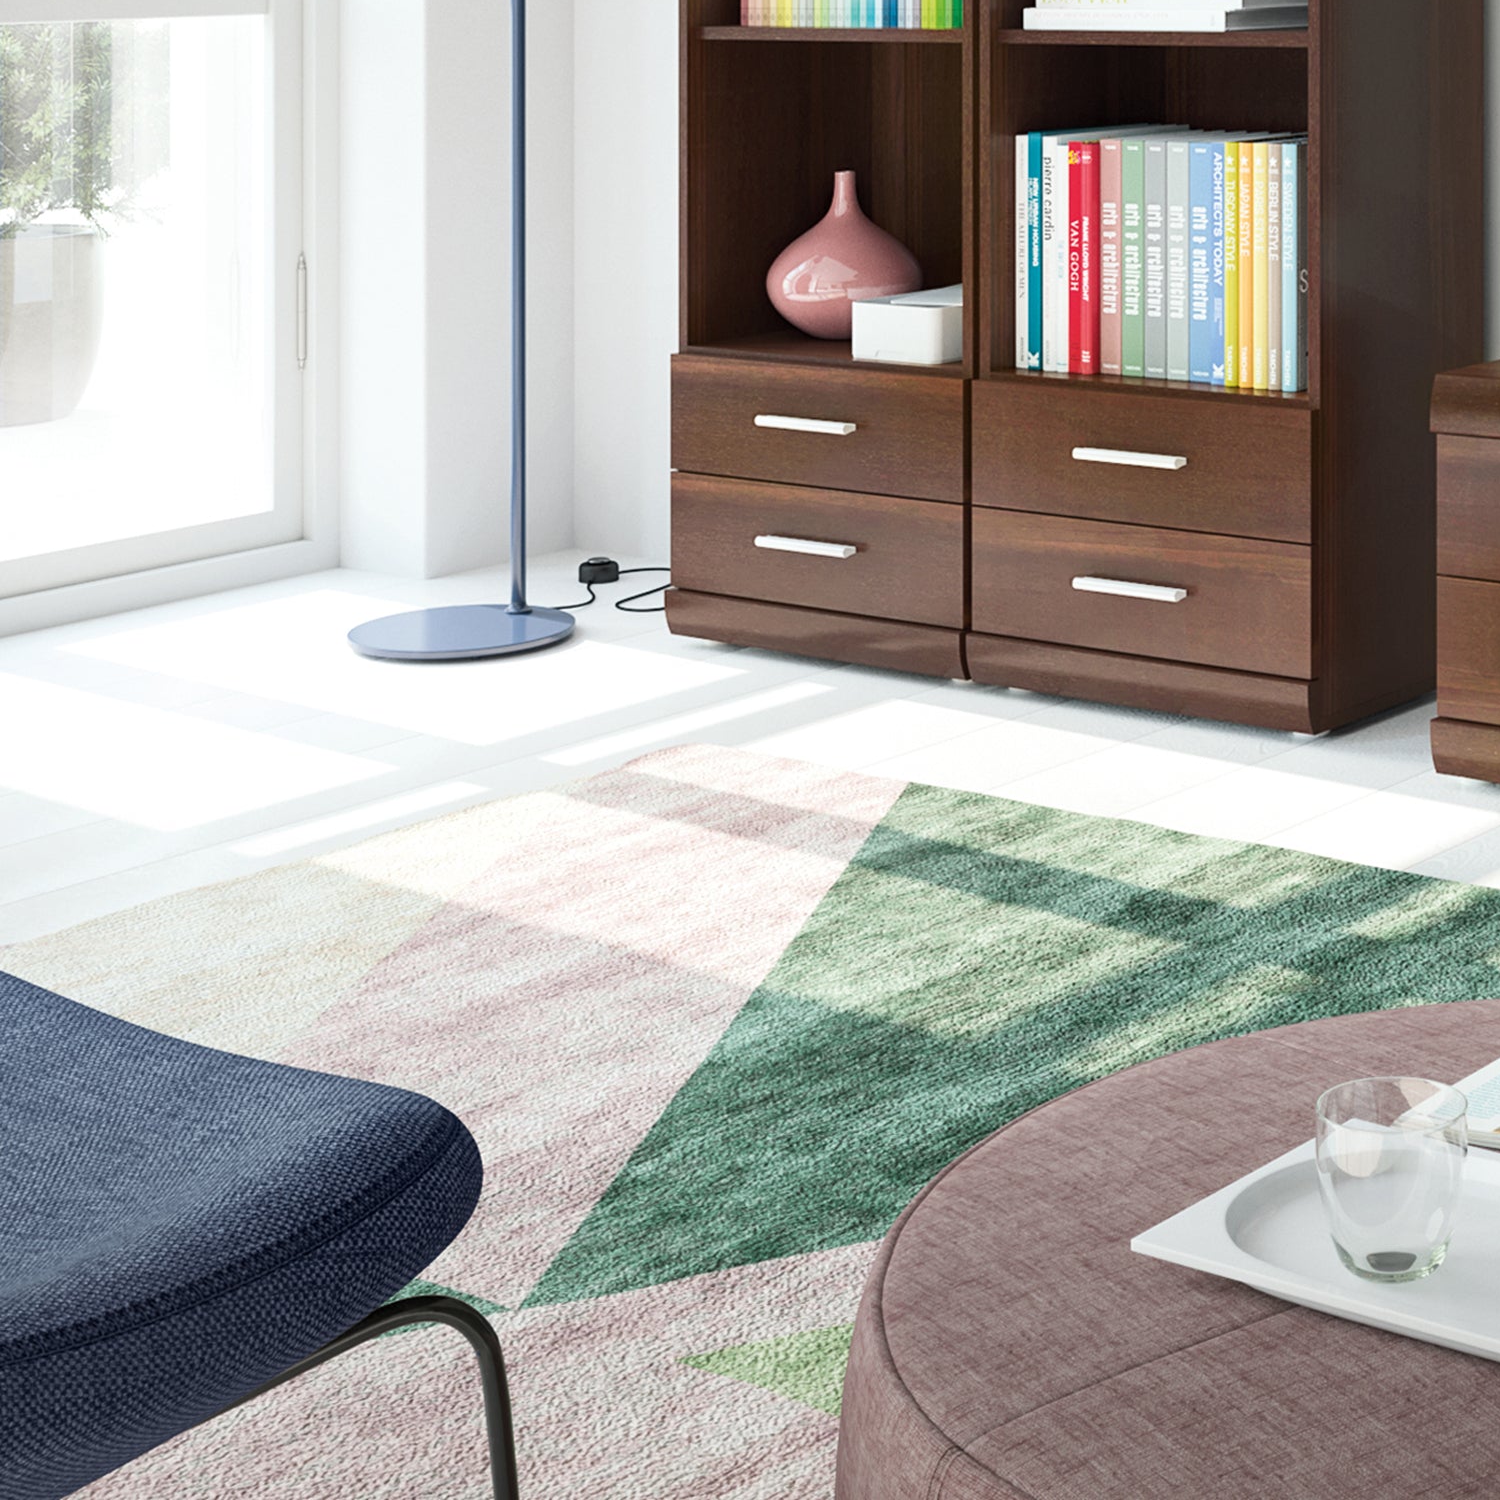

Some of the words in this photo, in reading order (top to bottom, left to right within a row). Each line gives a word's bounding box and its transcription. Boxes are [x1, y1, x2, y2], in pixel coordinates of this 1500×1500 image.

[1043, 156, 1055, 195] pierre
[1213, 152, 1223, 237] ARCHITECTS
[1225, 180, 1235, 232] TUSCANY
[1239, 180, 1249, 219] JAPAN
[1253, 181, 1263, 216] PARIS
[1268, 182, 1278, 224] BERLIN
[1283, 182, 1293, 234] SWEDEN
[1043, 198, 1055, 242] cardin
[1082, 216, 1090, 242] FRANK
[1102, 202, 1116, 226] arts
[1124, 203, 1138, 227] arts
[1146, 204, 1161, 228] arts
[1169, 205, 1184, 229] arts
[1192, 206, 1207, 231] arts
[1070, 220, 1080, 247] VAN
[1239, 222, 1249, 257] STYLE
[1253, 218, 1263, 253] STYLE
[1268, 226, 1278, 261] STYLE
[1082, 243, 1090, 269] LLOYD
[1213, 239, 1223, 286] TODAY
[1225, 236, 1235, 271] STYLE
[1283, 236, 1293, 270] STYLE
[1070, 251, 1080, 292] GOGH
[1082, 269, 1090, 303] WRIGHT
[1102, 243, 1119, 315] architecture
[1124, 244, 1141, 316] architecture
[1146, 246, 1163, 318] architecture
[1169, 247, 1186, 319] architecture
[1192, 248, 1209, 321] architecture
